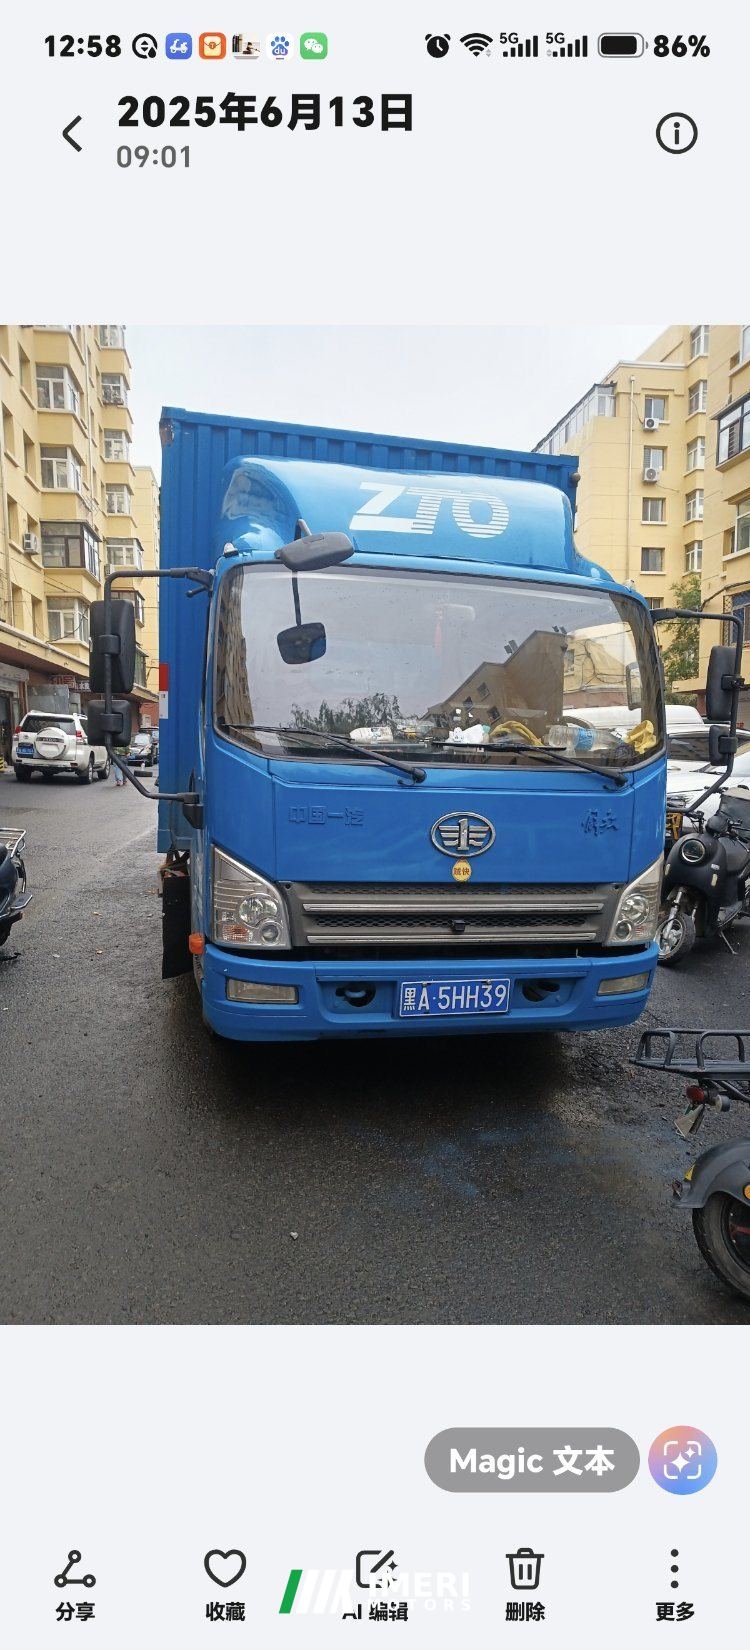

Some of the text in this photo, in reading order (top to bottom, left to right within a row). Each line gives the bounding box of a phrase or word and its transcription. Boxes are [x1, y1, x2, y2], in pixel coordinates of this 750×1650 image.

[45, 35, 121, 57] 12:58
[499, 32, 519, 44] 5G
[545, 32, 565, 44] 5G
[654, 35, 710, 57] 86%
[117, 92, 413, 131] 2025年6月13日
[116, 145, 191, 168] 09:01
[349, 481, 510, 539] ZTO
[288, 805, 364, 826] 中国一汽
[450, 1445, 616, 1479] Magic 文本
[56, 1602, 96, 1622] 分享
[206, 1602, 246, 1622] 收藏
[341, 1602, 409, 1622] AI 编辑
[505, 1602, 546, 1622] 删除
[655, 1602, 696, 1622] 更多
